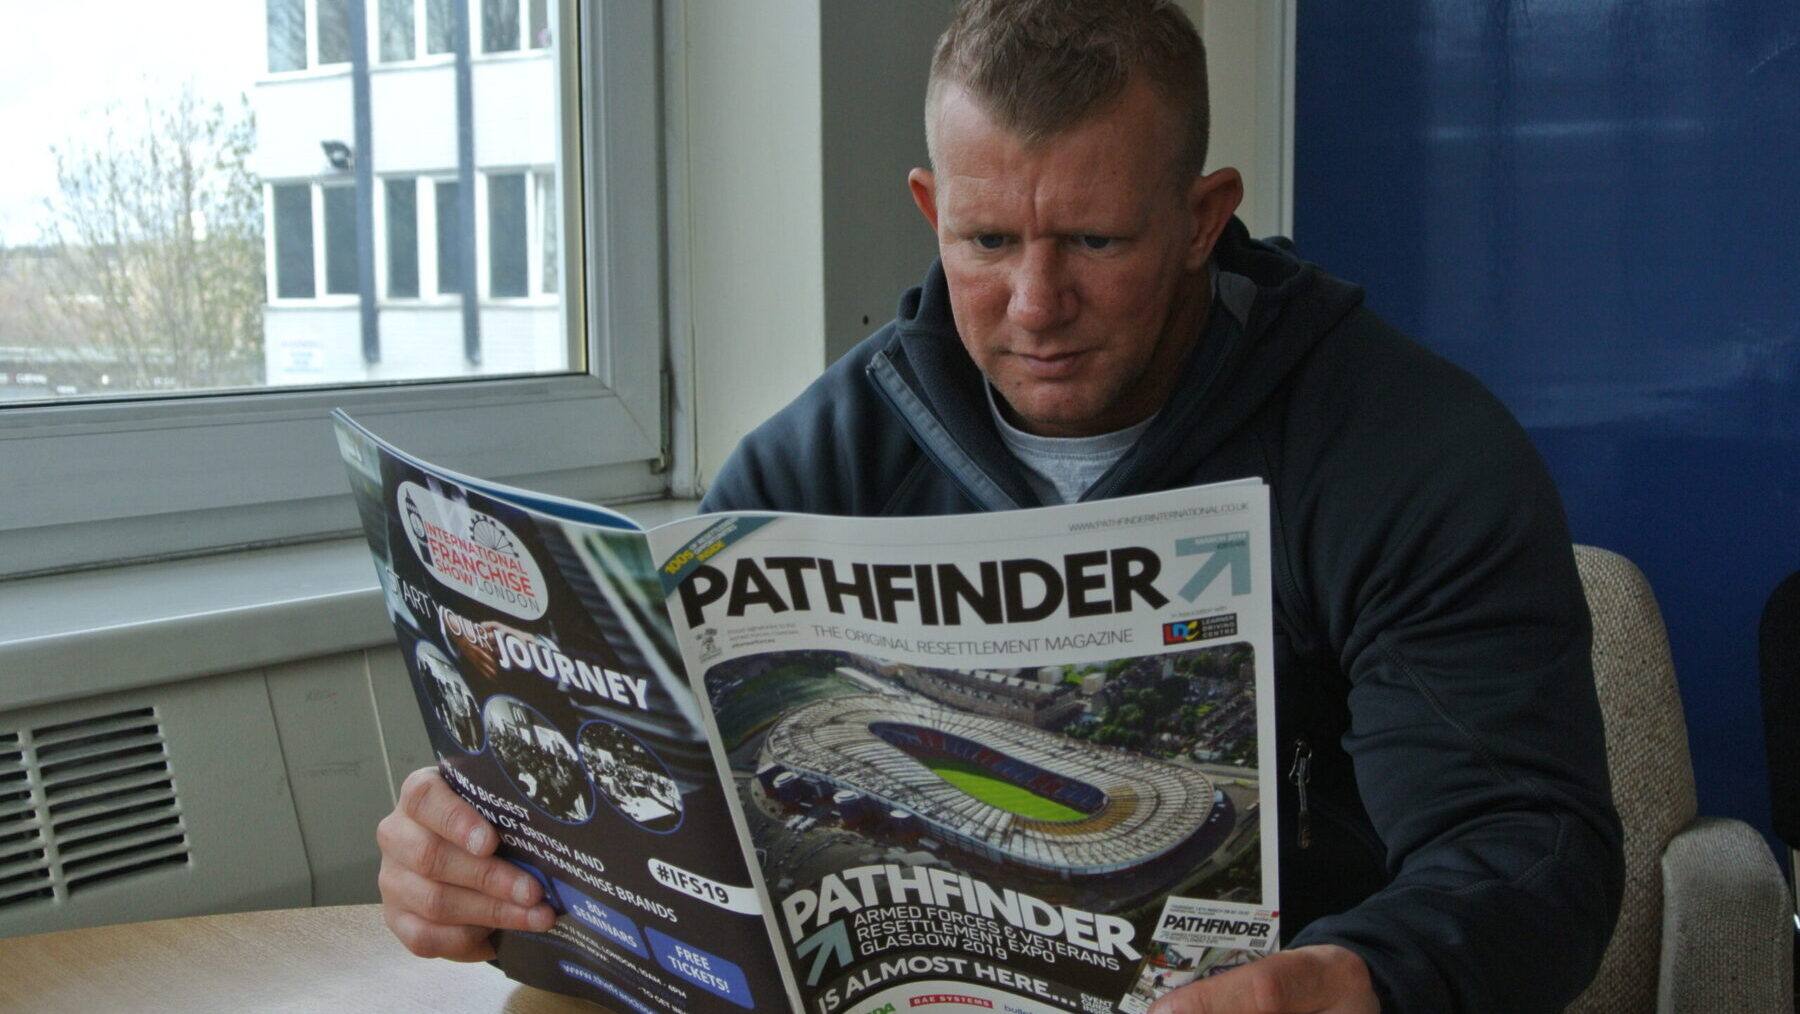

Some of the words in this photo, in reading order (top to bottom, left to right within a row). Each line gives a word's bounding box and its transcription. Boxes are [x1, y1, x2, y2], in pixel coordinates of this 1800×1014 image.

[1069, 503, 1249, 532] WWW.PATHFINDERINTERNATIONAL.CO.UK
[424, 521, 528, 576] INTERNATIONAL
[428, 537, 536, 598] FRANCHISE
[435, 558, 473, 588] SHOW
[475, 576, 541, 614] LONDON
[677, 546, 1170, 630] PATHFINDER
[811, 624, 842, 641] THE
[843, 627, 911, 651] ORIGINAL
[915, 640, 1041, 657] RESETTLEMENT
[1051, 628, 1135, 651] MAGAZINE
[494, 628, 649, 712] JOURNEY
[476, 785, 530, 821] BIGGEST
[498, 814, 519, 830] OF
[519, 822, 572, 857] BRITISH
[573, 849, 605, 873] AND
[543, 850, 615, 898] FRANCHISE
[615, 885, 678, 923] BRANDS
[655, 863, 730, 905] #IFS19
[572, 903, 638, 949] SEMINARS
[781, 863, 1143, 962] PATHFINDER
[1162, 914, 1271, 938] PATHFINDER
[675, 944, 711, 972] FREE
[853, 906, 923, 928] ARMED
[926, 905, 1000, 935] FORCES
[1003, 924, 1016, 939] &
[1015, 929, 1121, 972] VETERANS
[856, 918, 1004, 949] RESETTLEMENT
[1008, 940, 1056, 964] EXPO
[859, 931, 959, 956] GLASGOW
[961, 938, 1009, 961] 2019
[667, 954, 731, 994] TICKETS!
[817, 987, 841, 1014] IS
[844, 955, 968, 997] ALMOST
[974, 961, 1077, 1008] HERE...
[913, 996, 936, 1004] BAE
[938, 995, 991, 1007] SYSTEMS
